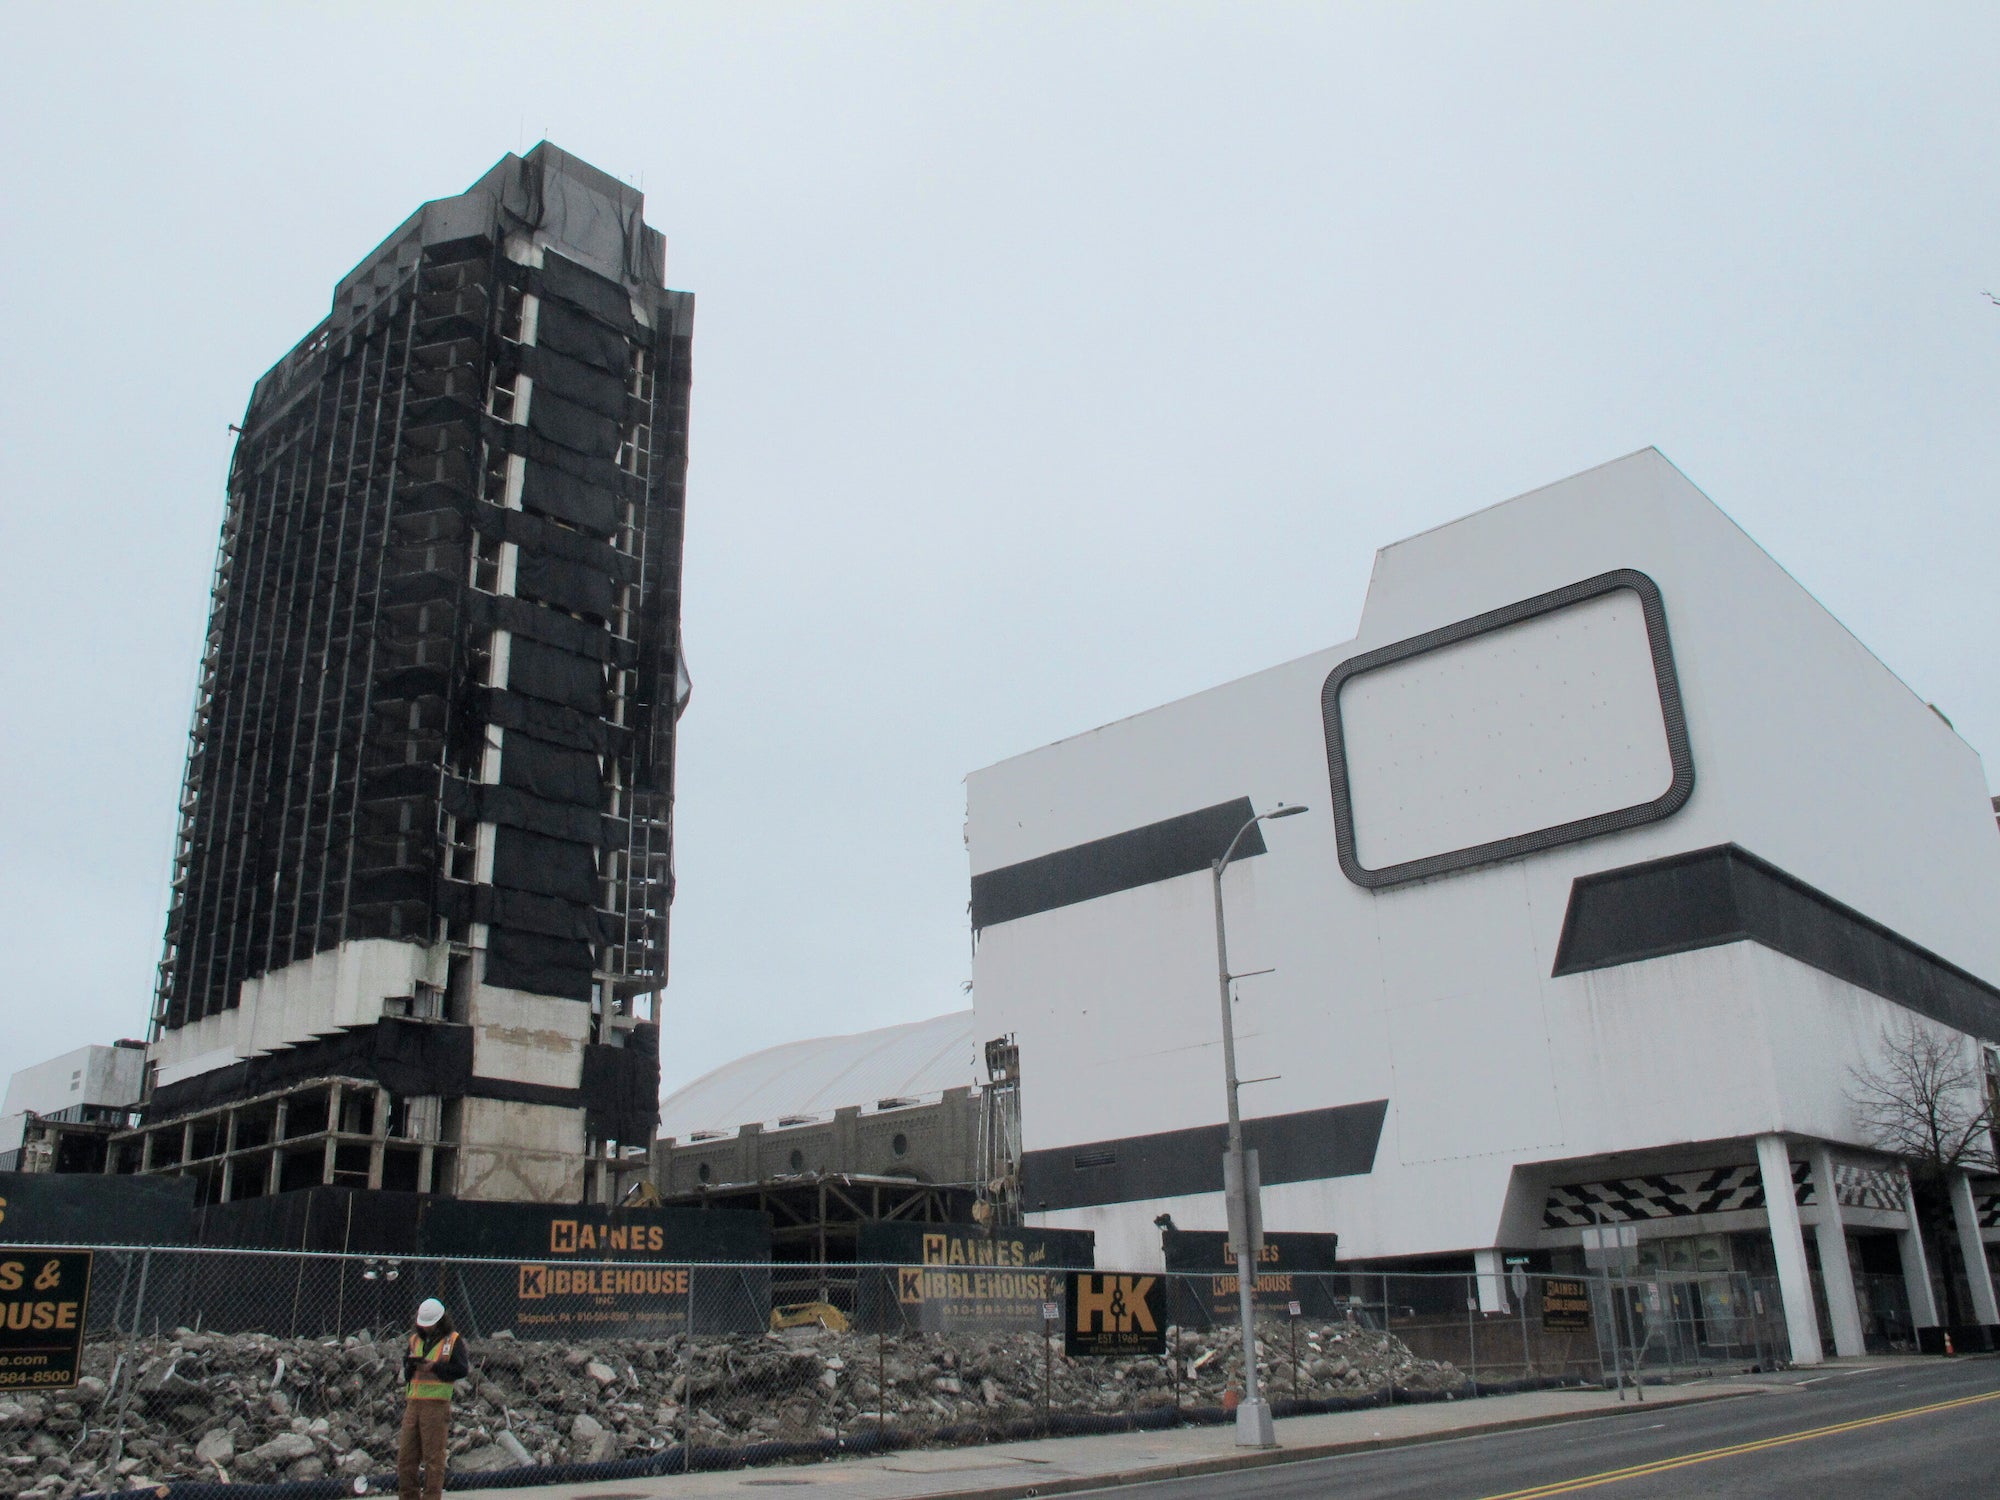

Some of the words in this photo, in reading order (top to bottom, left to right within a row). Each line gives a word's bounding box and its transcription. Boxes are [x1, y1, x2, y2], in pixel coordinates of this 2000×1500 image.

[551, 1220, 664, 1252] HAINES
[923, 1234, 1025, 1266] HAINES
[34, 1259, 61, 1290] &
[519, 1265, 688, 1298] KIBBLEHOUSE
[899, 1268, 1048, 1303] KIBBLEHOUSE
[1077, 1274, 1157, 1333] H&K
[1117, 1334, 1139, 1344] 1968
